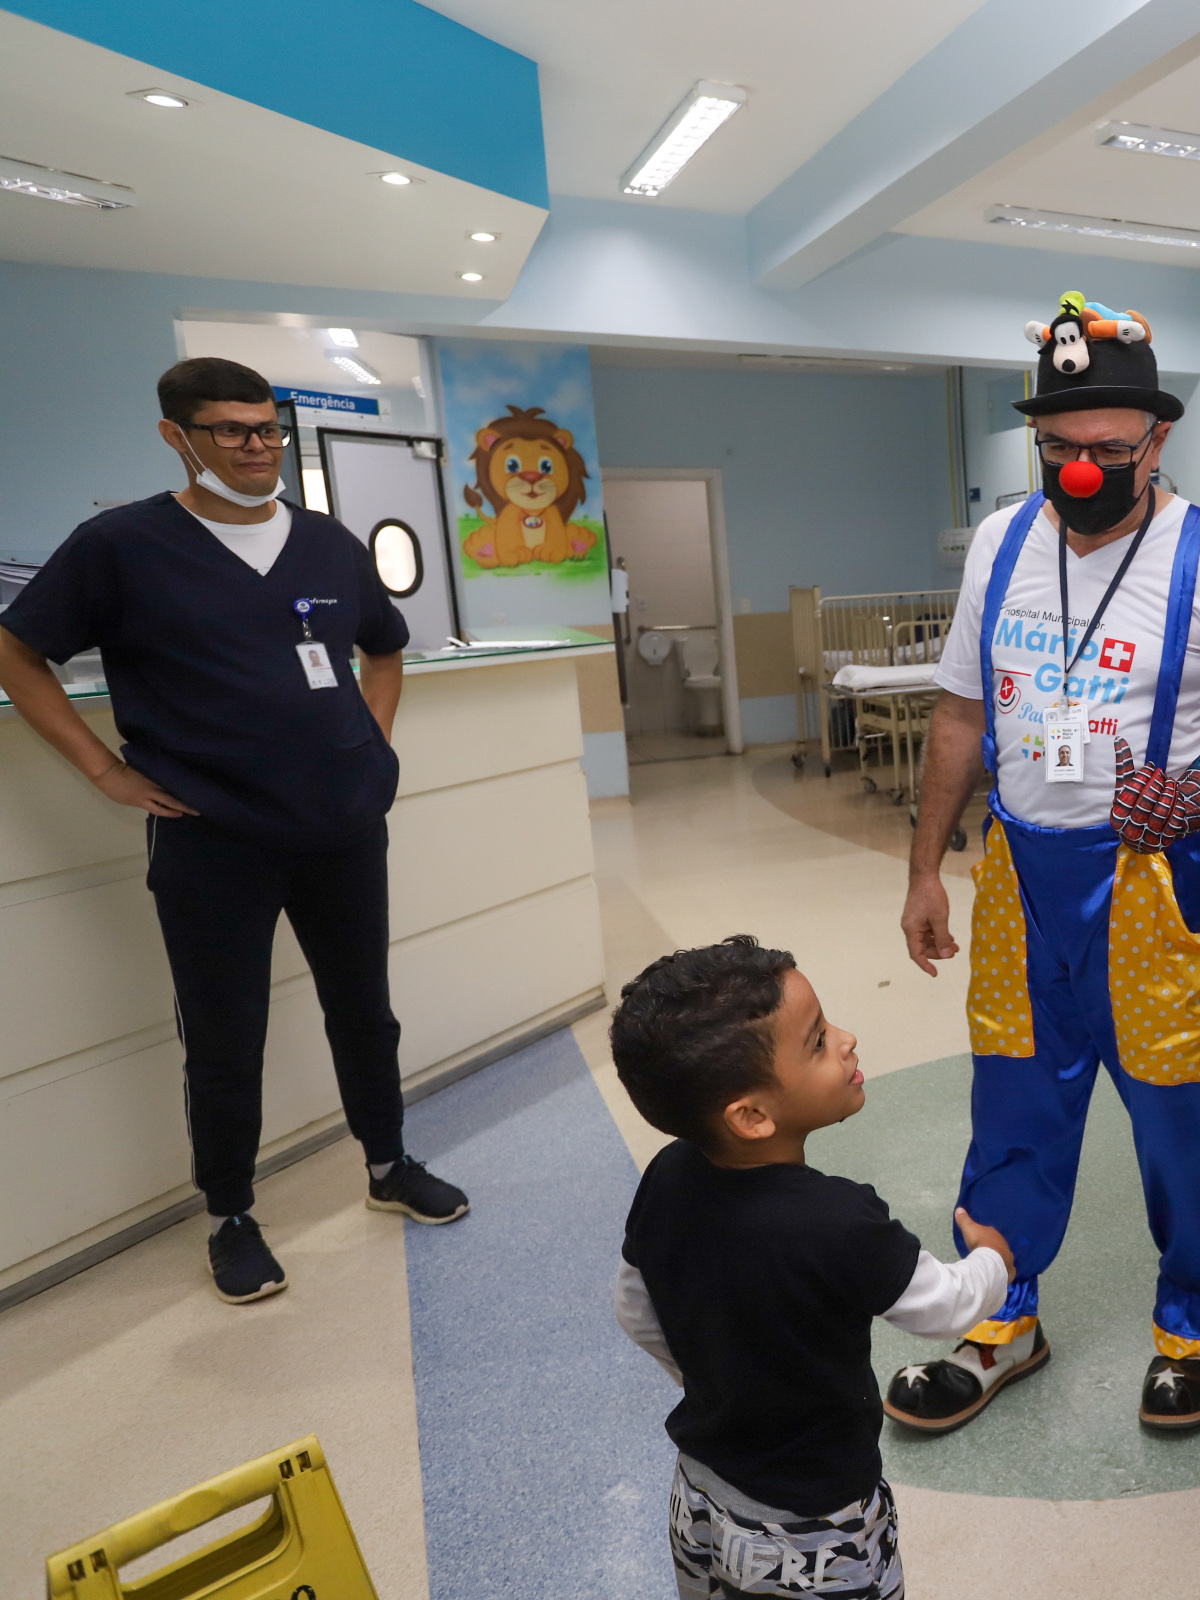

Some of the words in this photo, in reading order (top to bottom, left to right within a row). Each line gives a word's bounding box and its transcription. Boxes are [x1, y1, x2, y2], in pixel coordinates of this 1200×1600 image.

[290, 391, 356, 410] Emergência
[1004, 608, 1041, 620] Hospital
[1042, 611, 1090, 627] Muncipal
[995, 618, 1099, 661] Mário
[1034, 663, 1130, 704] Gatti
[1088, 717, 1119, 736] atti
